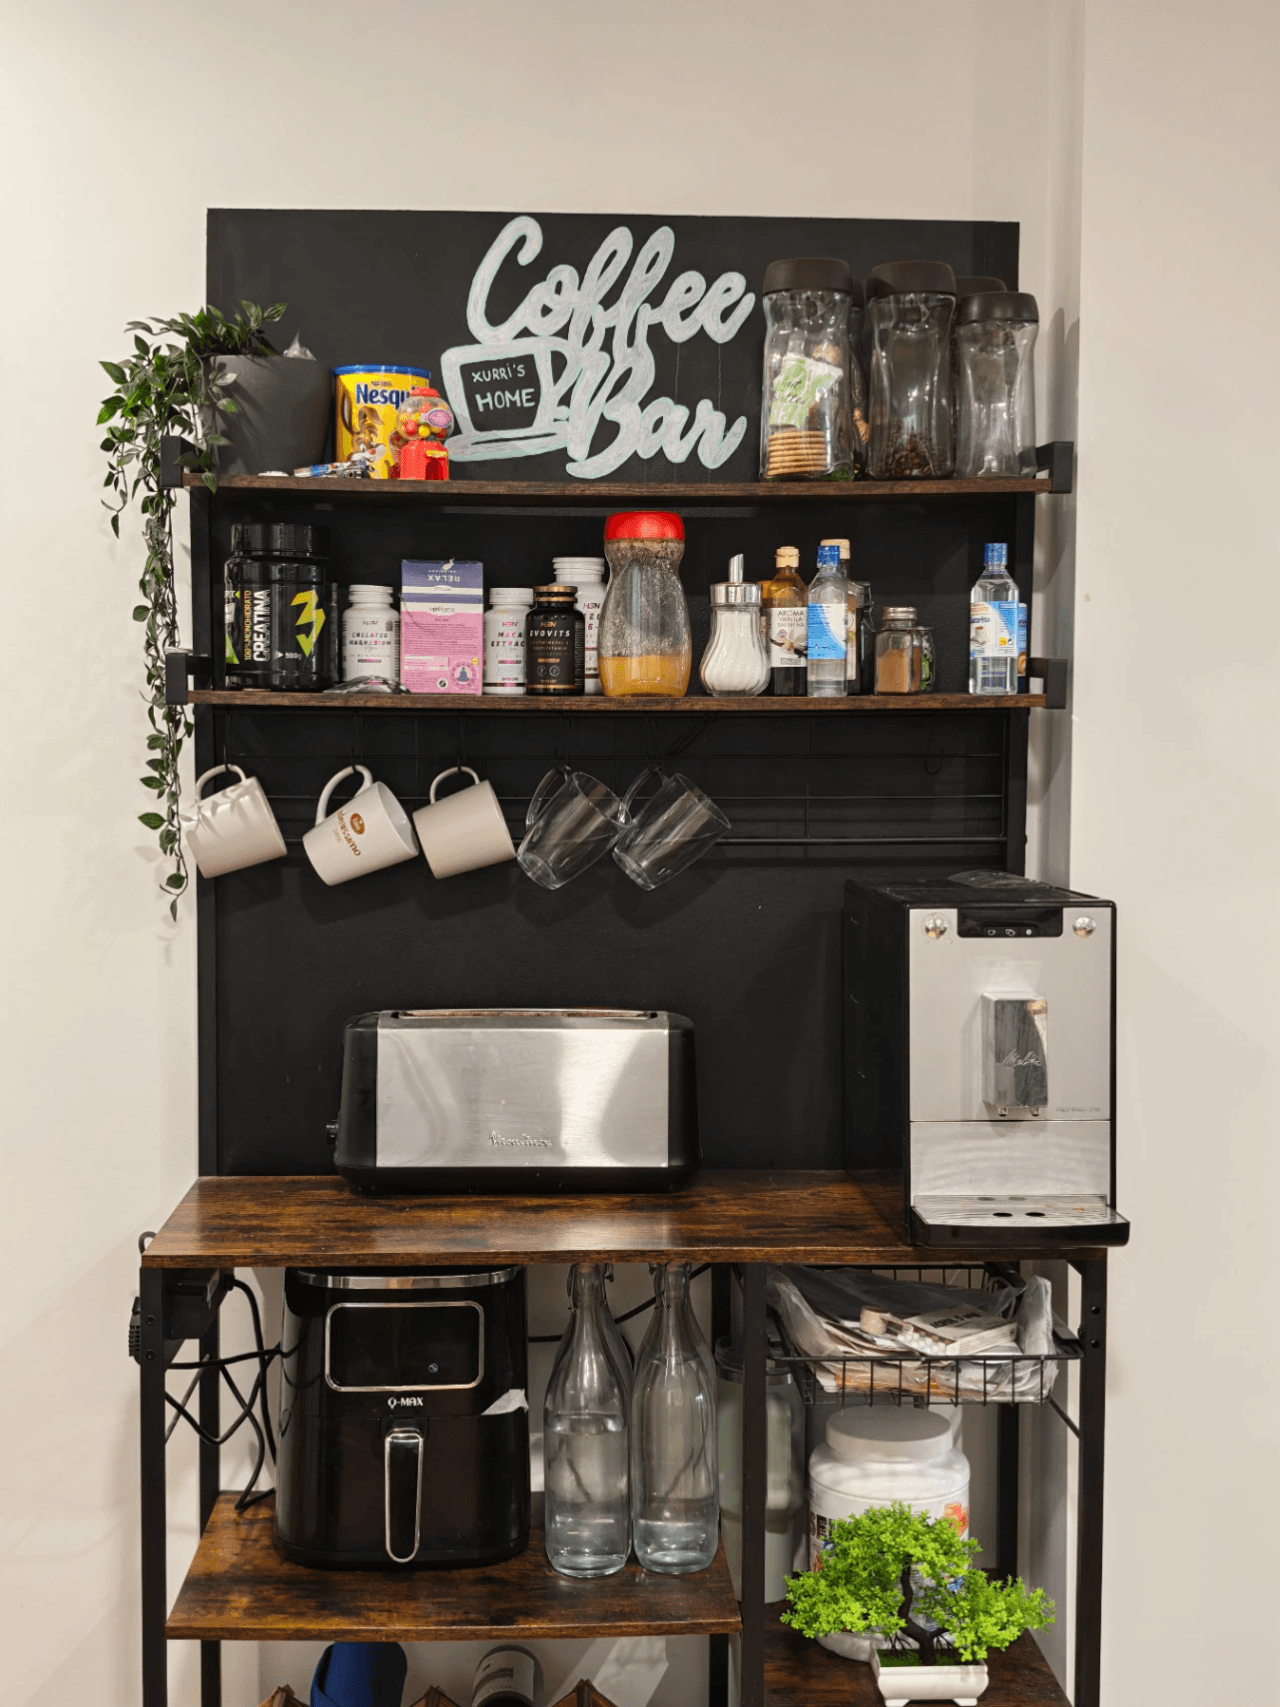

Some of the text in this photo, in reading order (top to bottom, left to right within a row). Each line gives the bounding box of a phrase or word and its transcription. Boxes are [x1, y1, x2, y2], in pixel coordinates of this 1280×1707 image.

[467, 216, 756, 356] Coffee
[355, 382, 411, 410] Nesqu
[475, 387, 536, 413] HOME
[560, 349, 748, 479] Bar
[427, 574, 460, 582] RELAX
[253, 589, 270, 662] CREATINA
[529, 629, 571, 638] EVOVITS
[387, 1397, 424, 1409] Q-MAX
